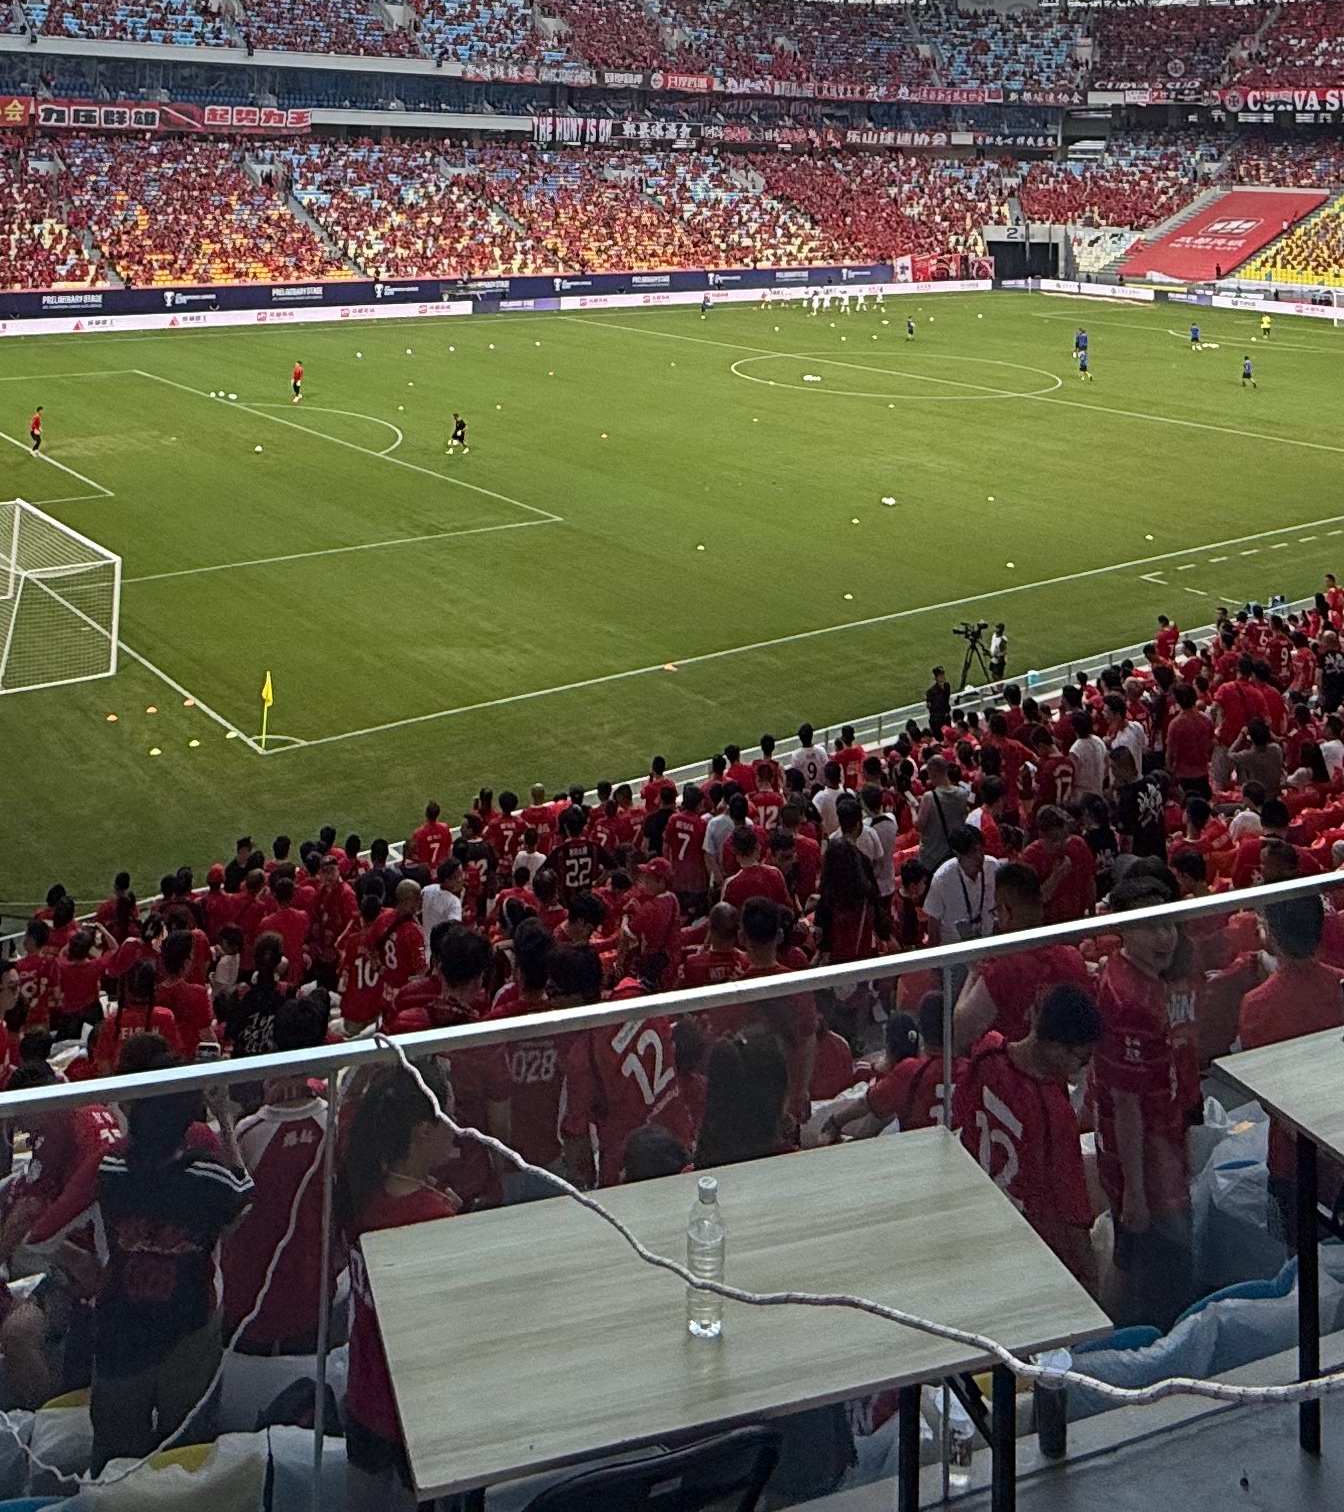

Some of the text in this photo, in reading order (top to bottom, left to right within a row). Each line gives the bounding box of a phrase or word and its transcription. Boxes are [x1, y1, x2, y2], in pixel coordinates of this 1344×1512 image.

[1247, 89, 1321, 111] CVA
[39, 106, 159, 127] 力压群雄
[1007, 227, 1018, 239] 2
[807, 761, 817, 781] 9
[758, 805, 779, 830] 12
[503, 830, 513, 851] 7
[677, 832, 691, 861] 7
[429, 842, 441, 863] 7
[565, 857, 592, 888] 22
[385, 940, 397, 970] 8
[354, 957, 380, 989] 10
[621, 1029, 675, 1105] 12
